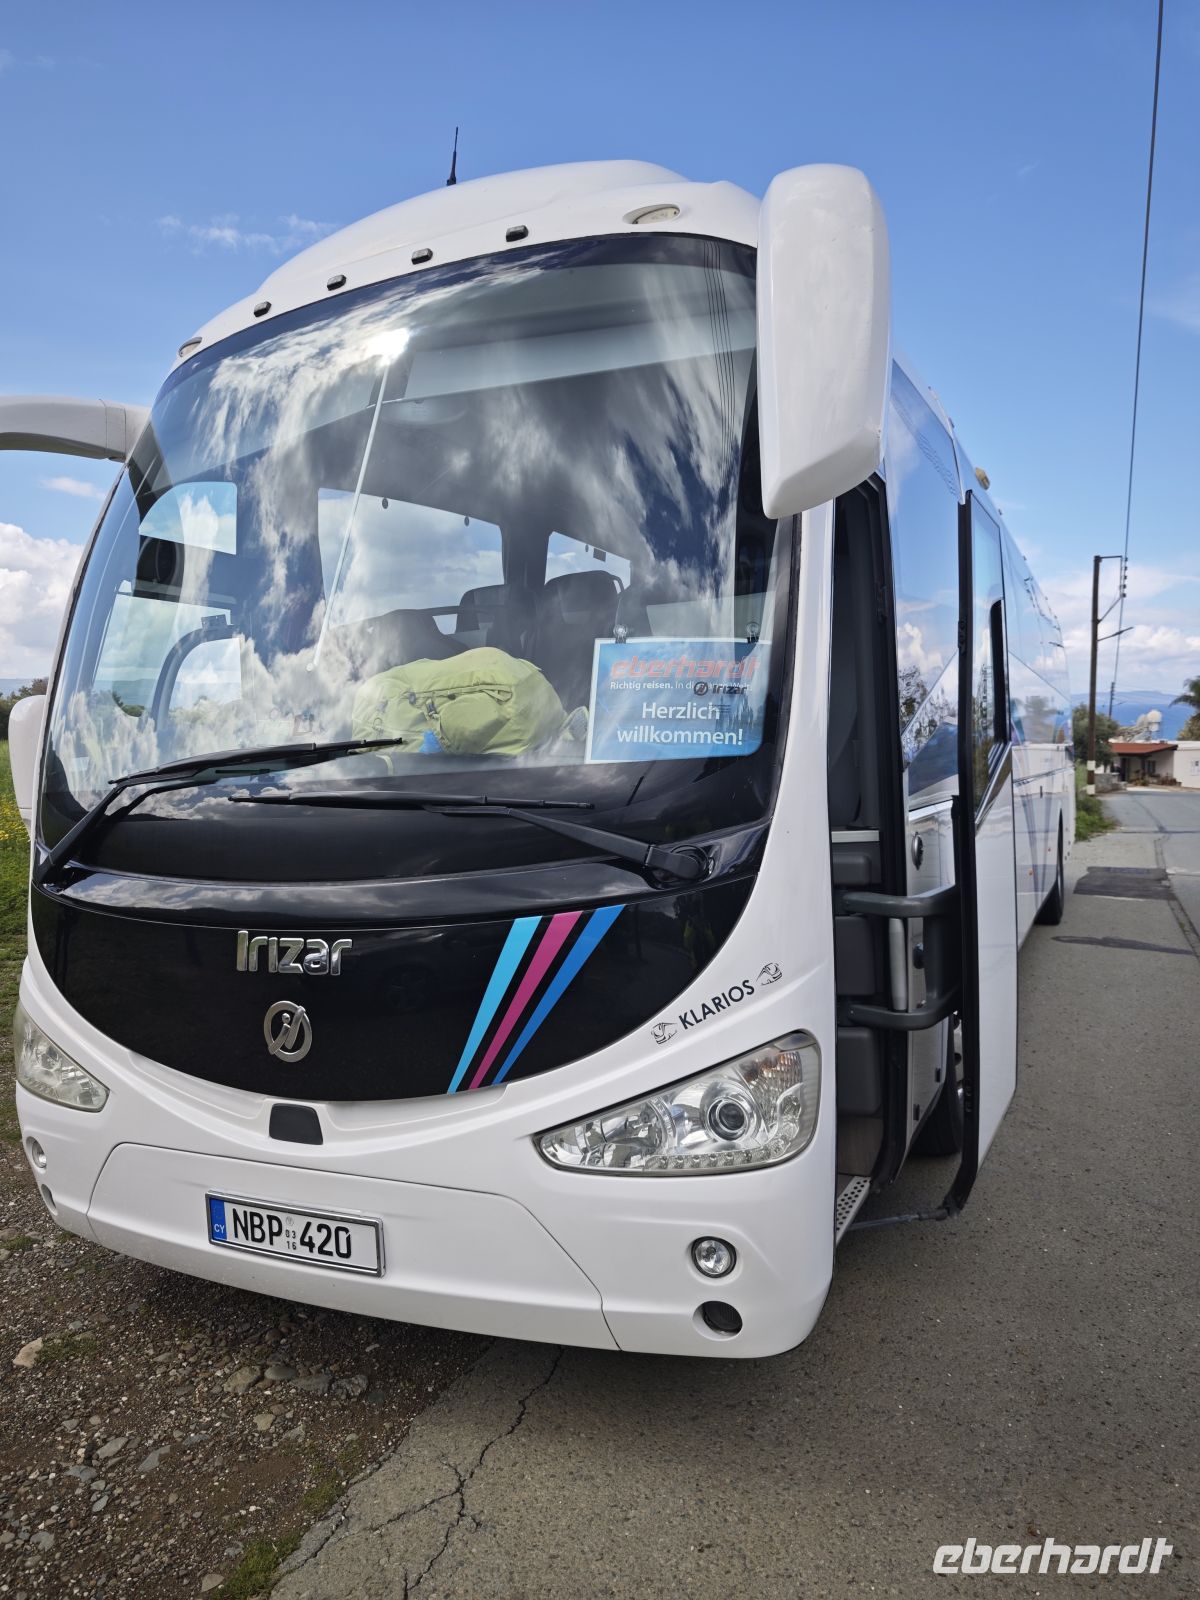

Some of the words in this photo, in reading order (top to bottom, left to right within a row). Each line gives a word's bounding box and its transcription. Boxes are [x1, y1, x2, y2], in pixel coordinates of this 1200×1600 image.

[610, 655, 760, 679] eberhardt
[610, 681, 641, 691] Richtig
[643, 681, 673, 689] reisen.
[675, 681, 684, 689] In
[712, 684, 747, 694] Irizar
[641, 702, 720, 720] Herzlich
[617, 725, 743, 746] willkommen!
[236, 930, 352, 976] Irizar
[678, 979, 755, 1030] KLARIOS
[213, 1223, 225, 1234] CY
[232, 1208, 282, 1246] NBP
[300, 1221, 352, 1259] 420
[285, 1229, 296, 1239] 03
[286, 1240, 297, 1250] 16
